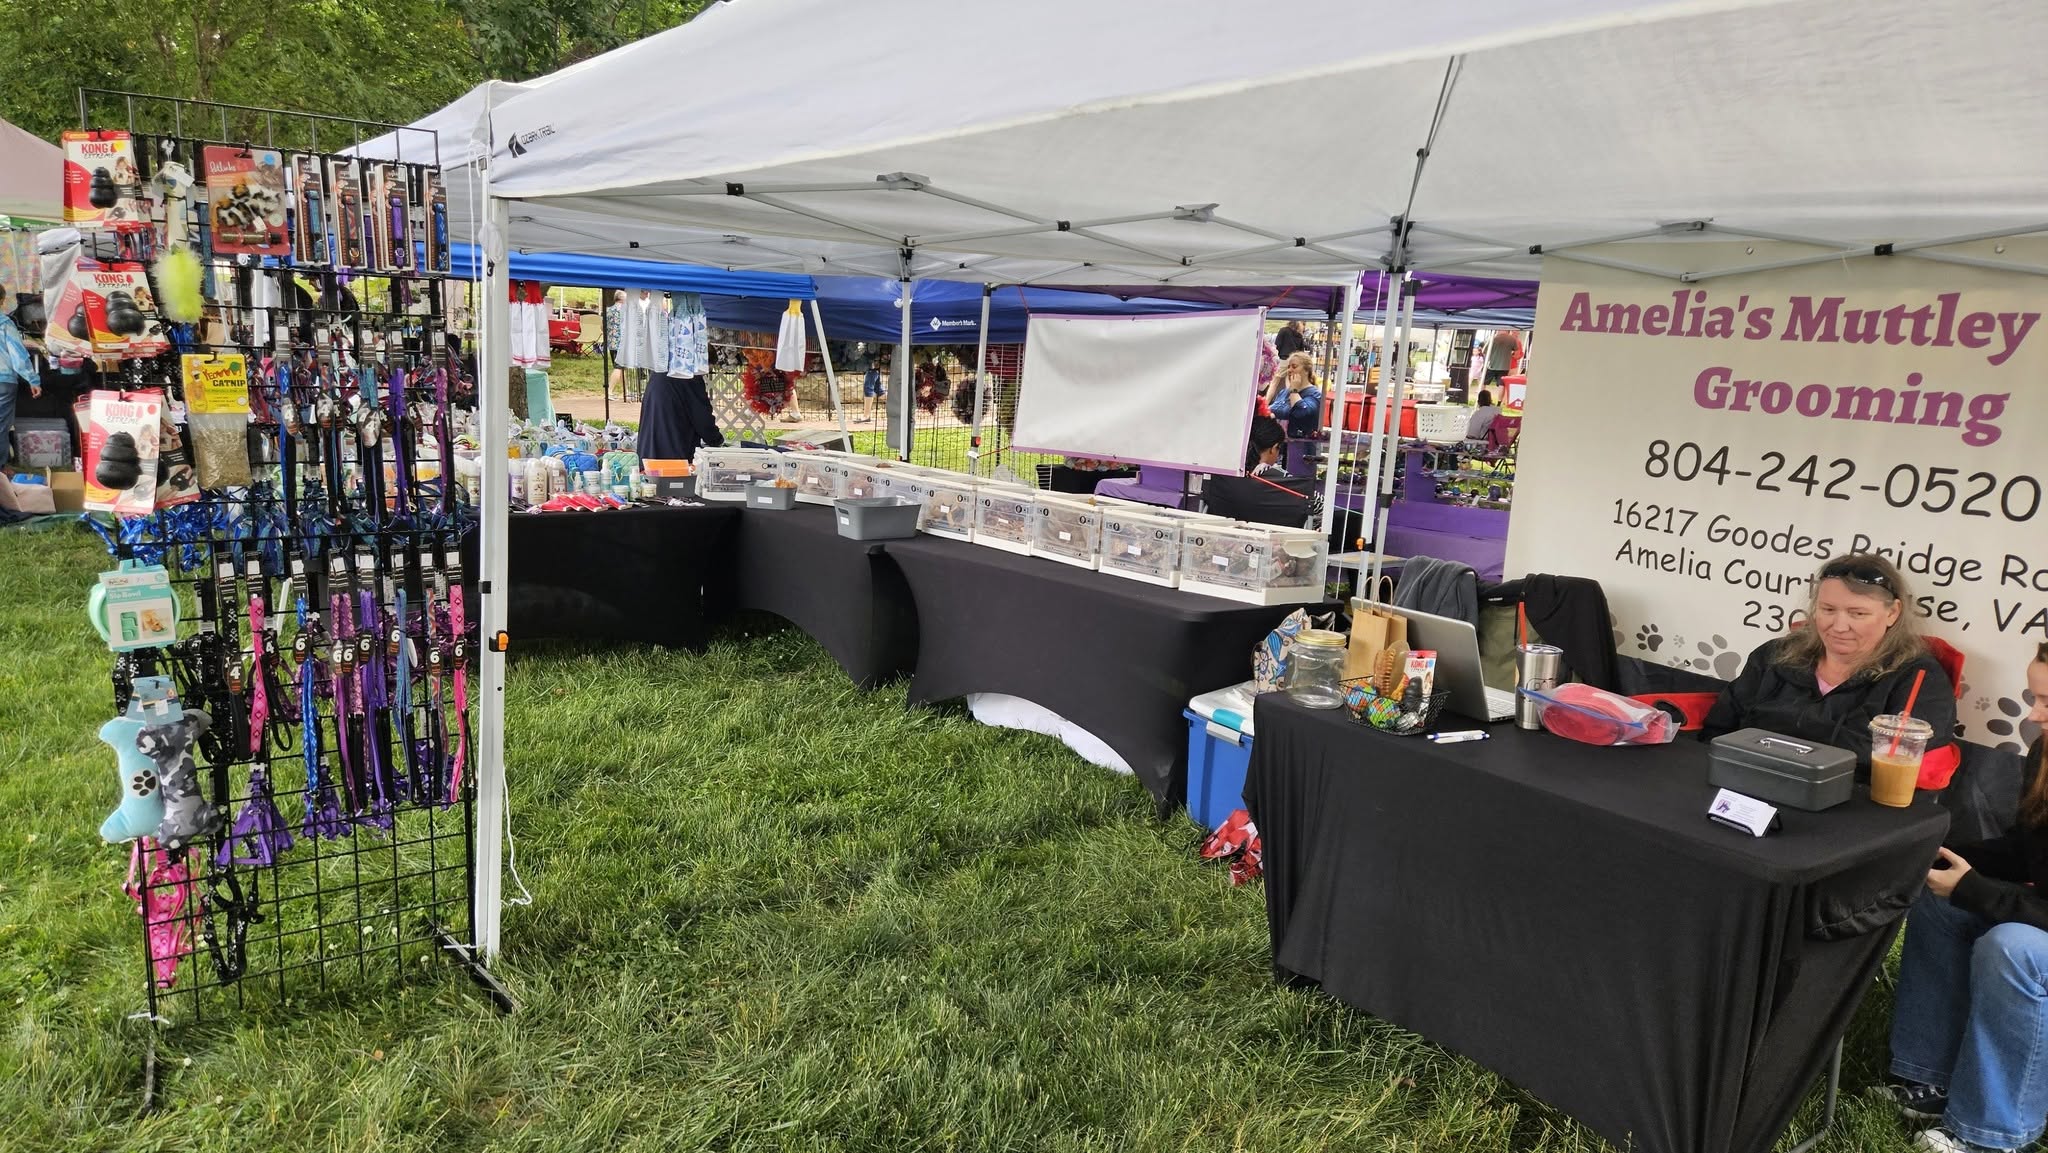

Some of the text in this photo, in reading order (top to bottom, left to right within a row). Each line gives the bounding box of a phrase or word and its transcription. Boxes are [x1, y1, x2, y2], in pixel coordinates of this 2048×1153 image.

[81, 143, 109, 154] KONG
[93, 273, 124, 284] KONG
[1559, 289, 2042, 366] Amelia's Muttley
[212, 379, 246, 387] CATNIP
[105, 403, 135, 417] KONG
[1693, 366, 2011, 447] Grooming
[1644, 439, 2042, 523] 804-242-0520
[1613, 498, 1699, 537] 16217
[1707, 514, 1834, 560] Goodes
[1850, 533, 1983, 587] Bridge
[1615, 538, 1712, 581] Amelia
[1993, 598, 2048, 639] VA
[1410, 660, 1425, 668] KONG
